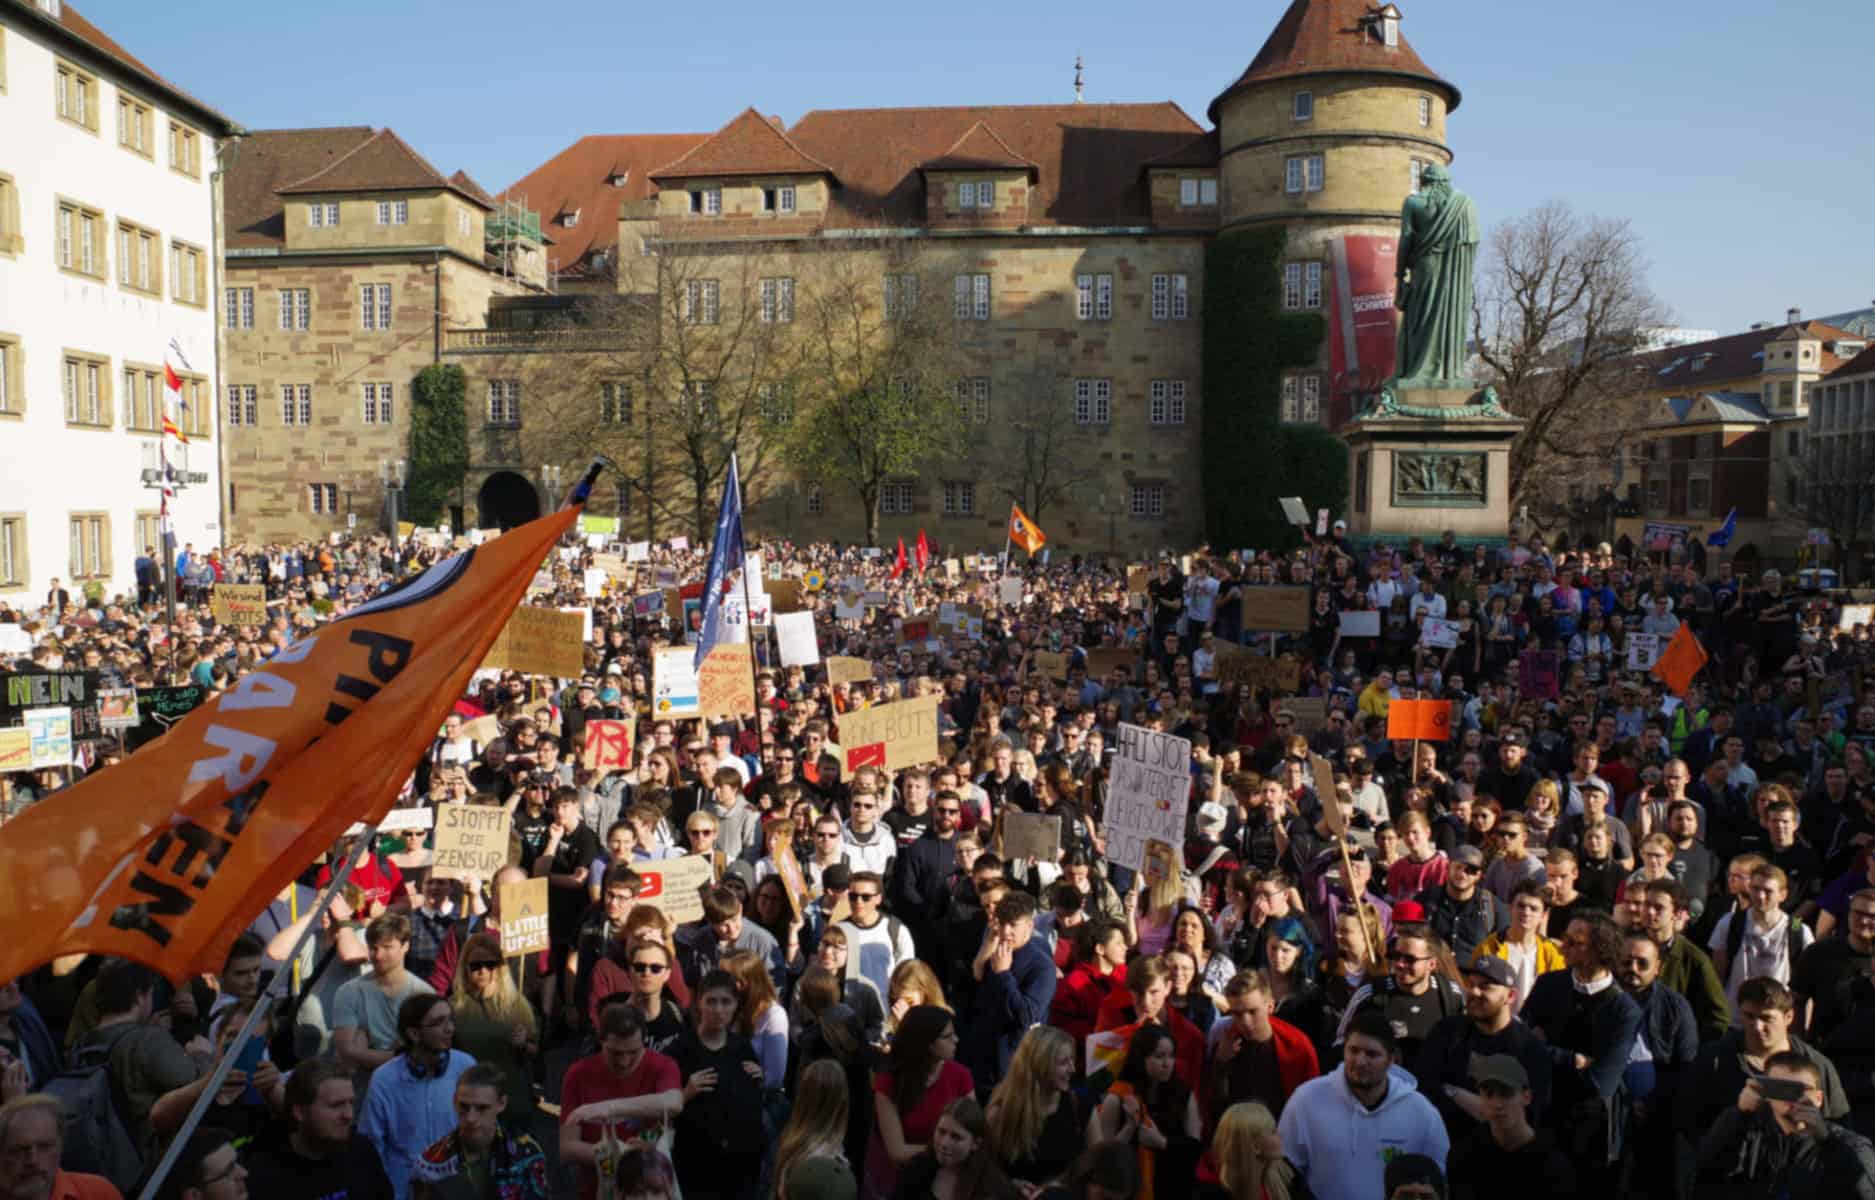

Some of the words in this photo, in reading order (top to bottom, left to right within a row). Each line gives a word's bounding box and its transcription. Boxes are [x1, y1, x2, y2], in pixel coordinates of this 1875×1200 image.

[8, 674, 84, 706] NEIN
[1120, 726, 1149, 763] HALT
[445, 807, 504, 832] STOPPT
[459, 832, 485, 847] DIE
[434, 849, 502, 871] ZENSUR
